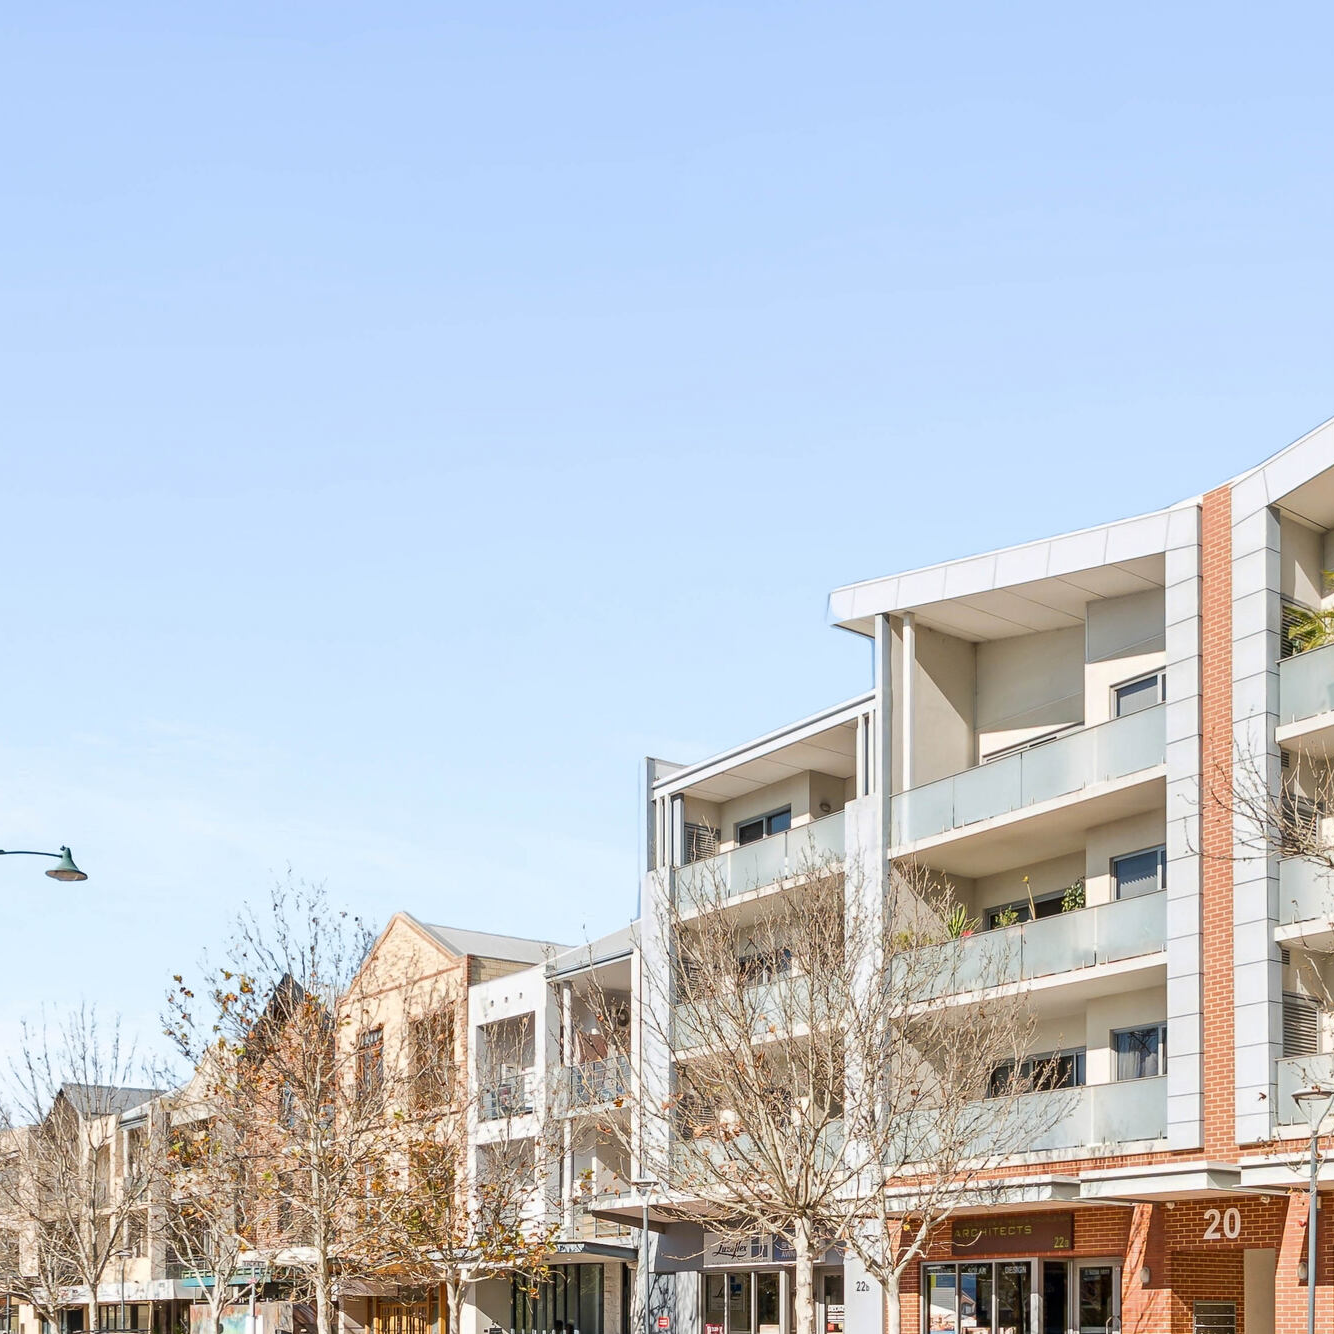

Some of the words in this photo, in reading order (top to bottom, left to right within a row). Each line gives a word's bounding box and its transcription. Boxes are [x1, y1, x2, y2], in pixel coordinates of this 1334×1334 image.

[1203, 1207, 1241, 1240] 20
[954, 1225, 1032, 1239] ARCHITECTS
[1053, 1237, 1070, 1249] 22a
[856, 1281, 870, 1292] 22b
